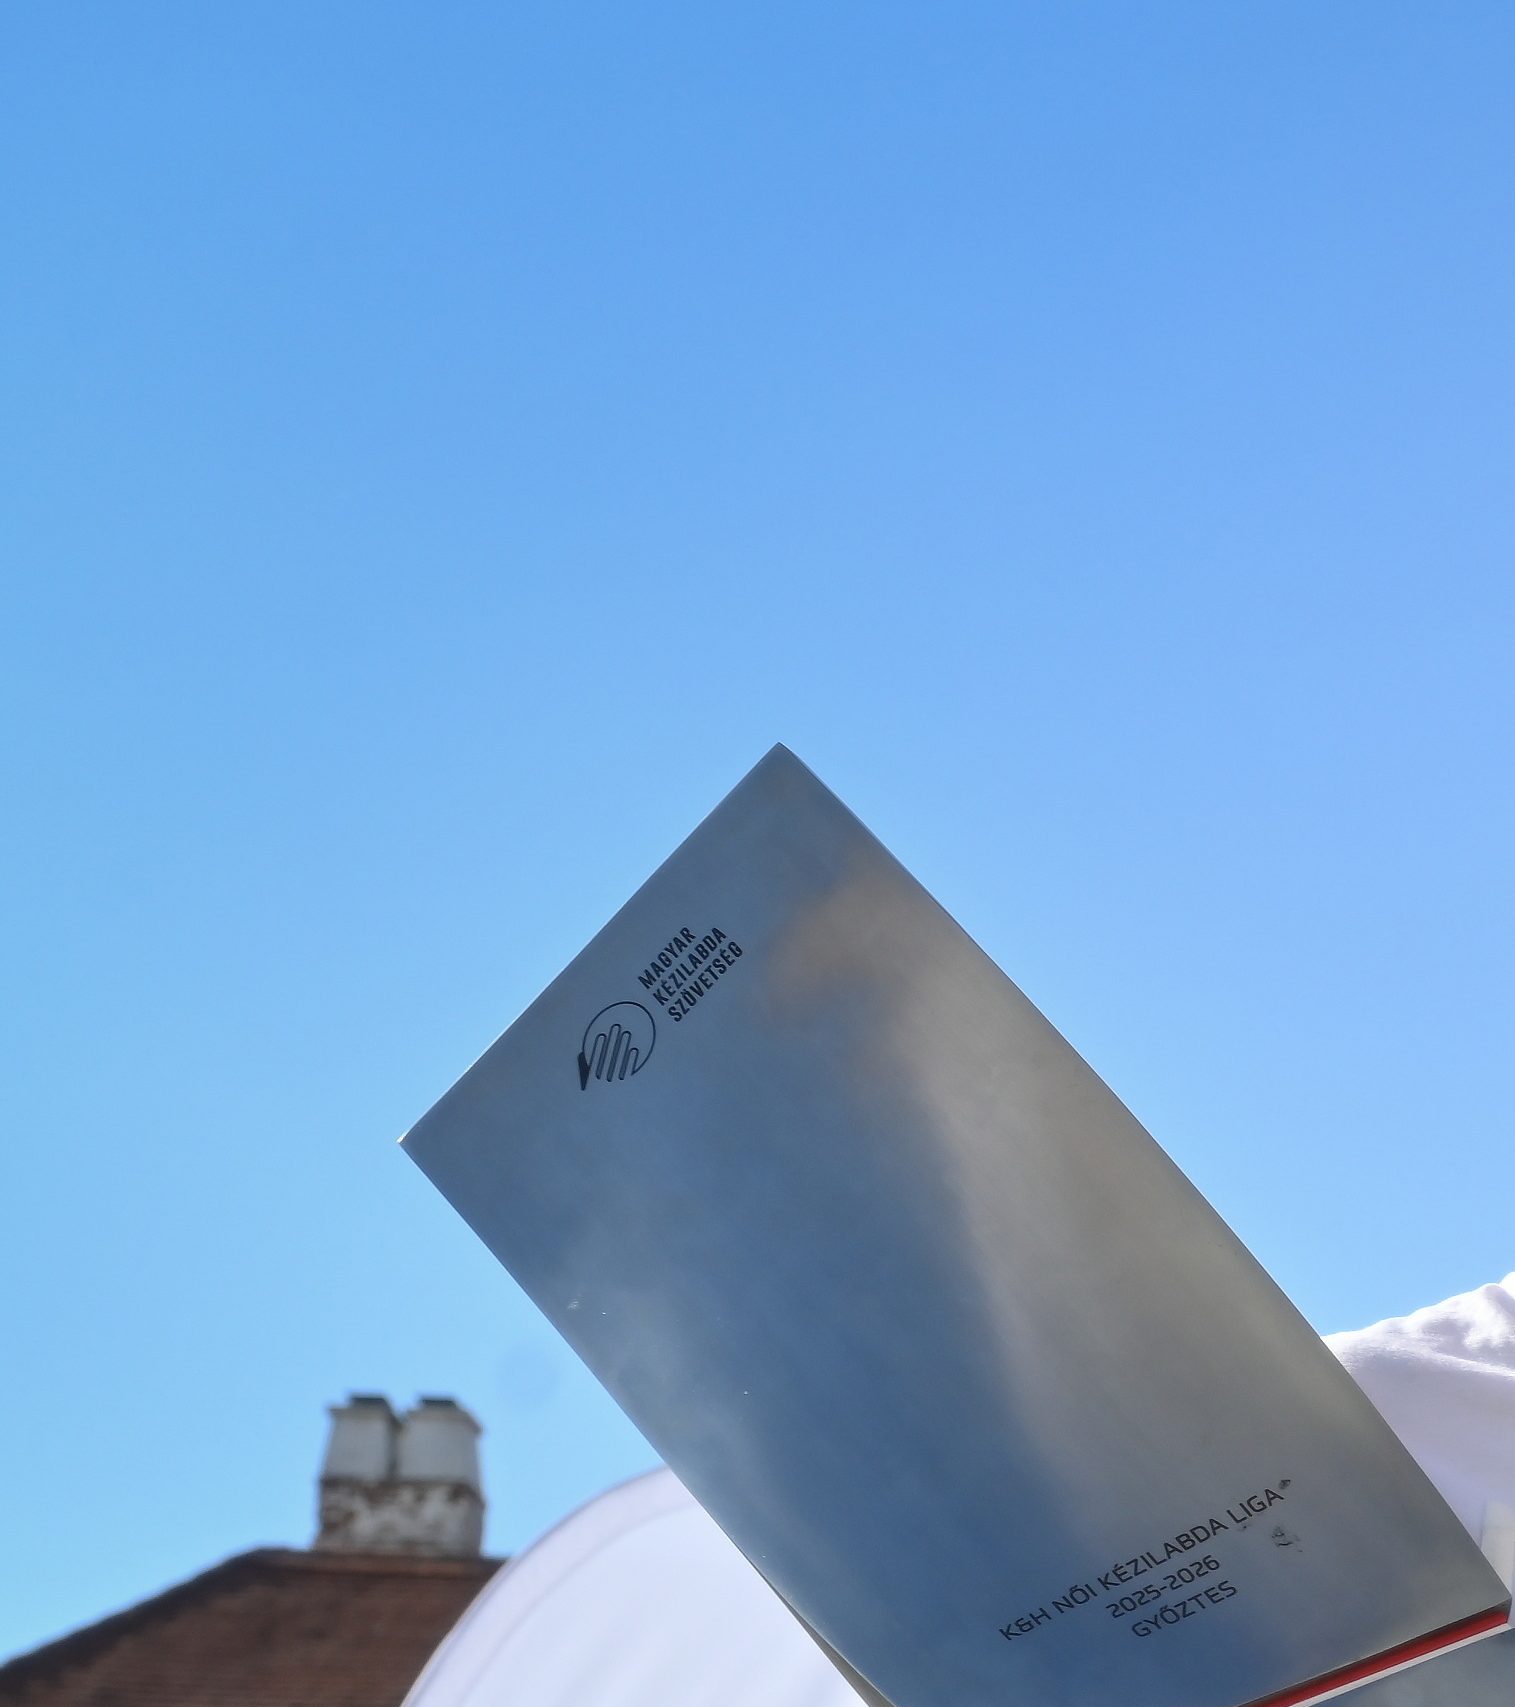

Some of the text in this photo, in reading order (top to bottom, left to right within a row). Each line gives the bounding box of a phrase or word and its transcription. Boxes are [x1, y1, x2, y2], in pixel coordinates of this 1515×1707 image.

[638, 926, 697, 990] MAGYAR
[652, 927, 727, 1006] KÉZILABDA
[668, 941, 744, 1023] SZÖVETSÉG
[998, 1487, 1285, 1641] K&H NŐI KÉZILABDA LIGA
[1104, 1554, 1221, 1619] 2025-2026
[1131, 1580, 1239, 1638] GYŐZTES
